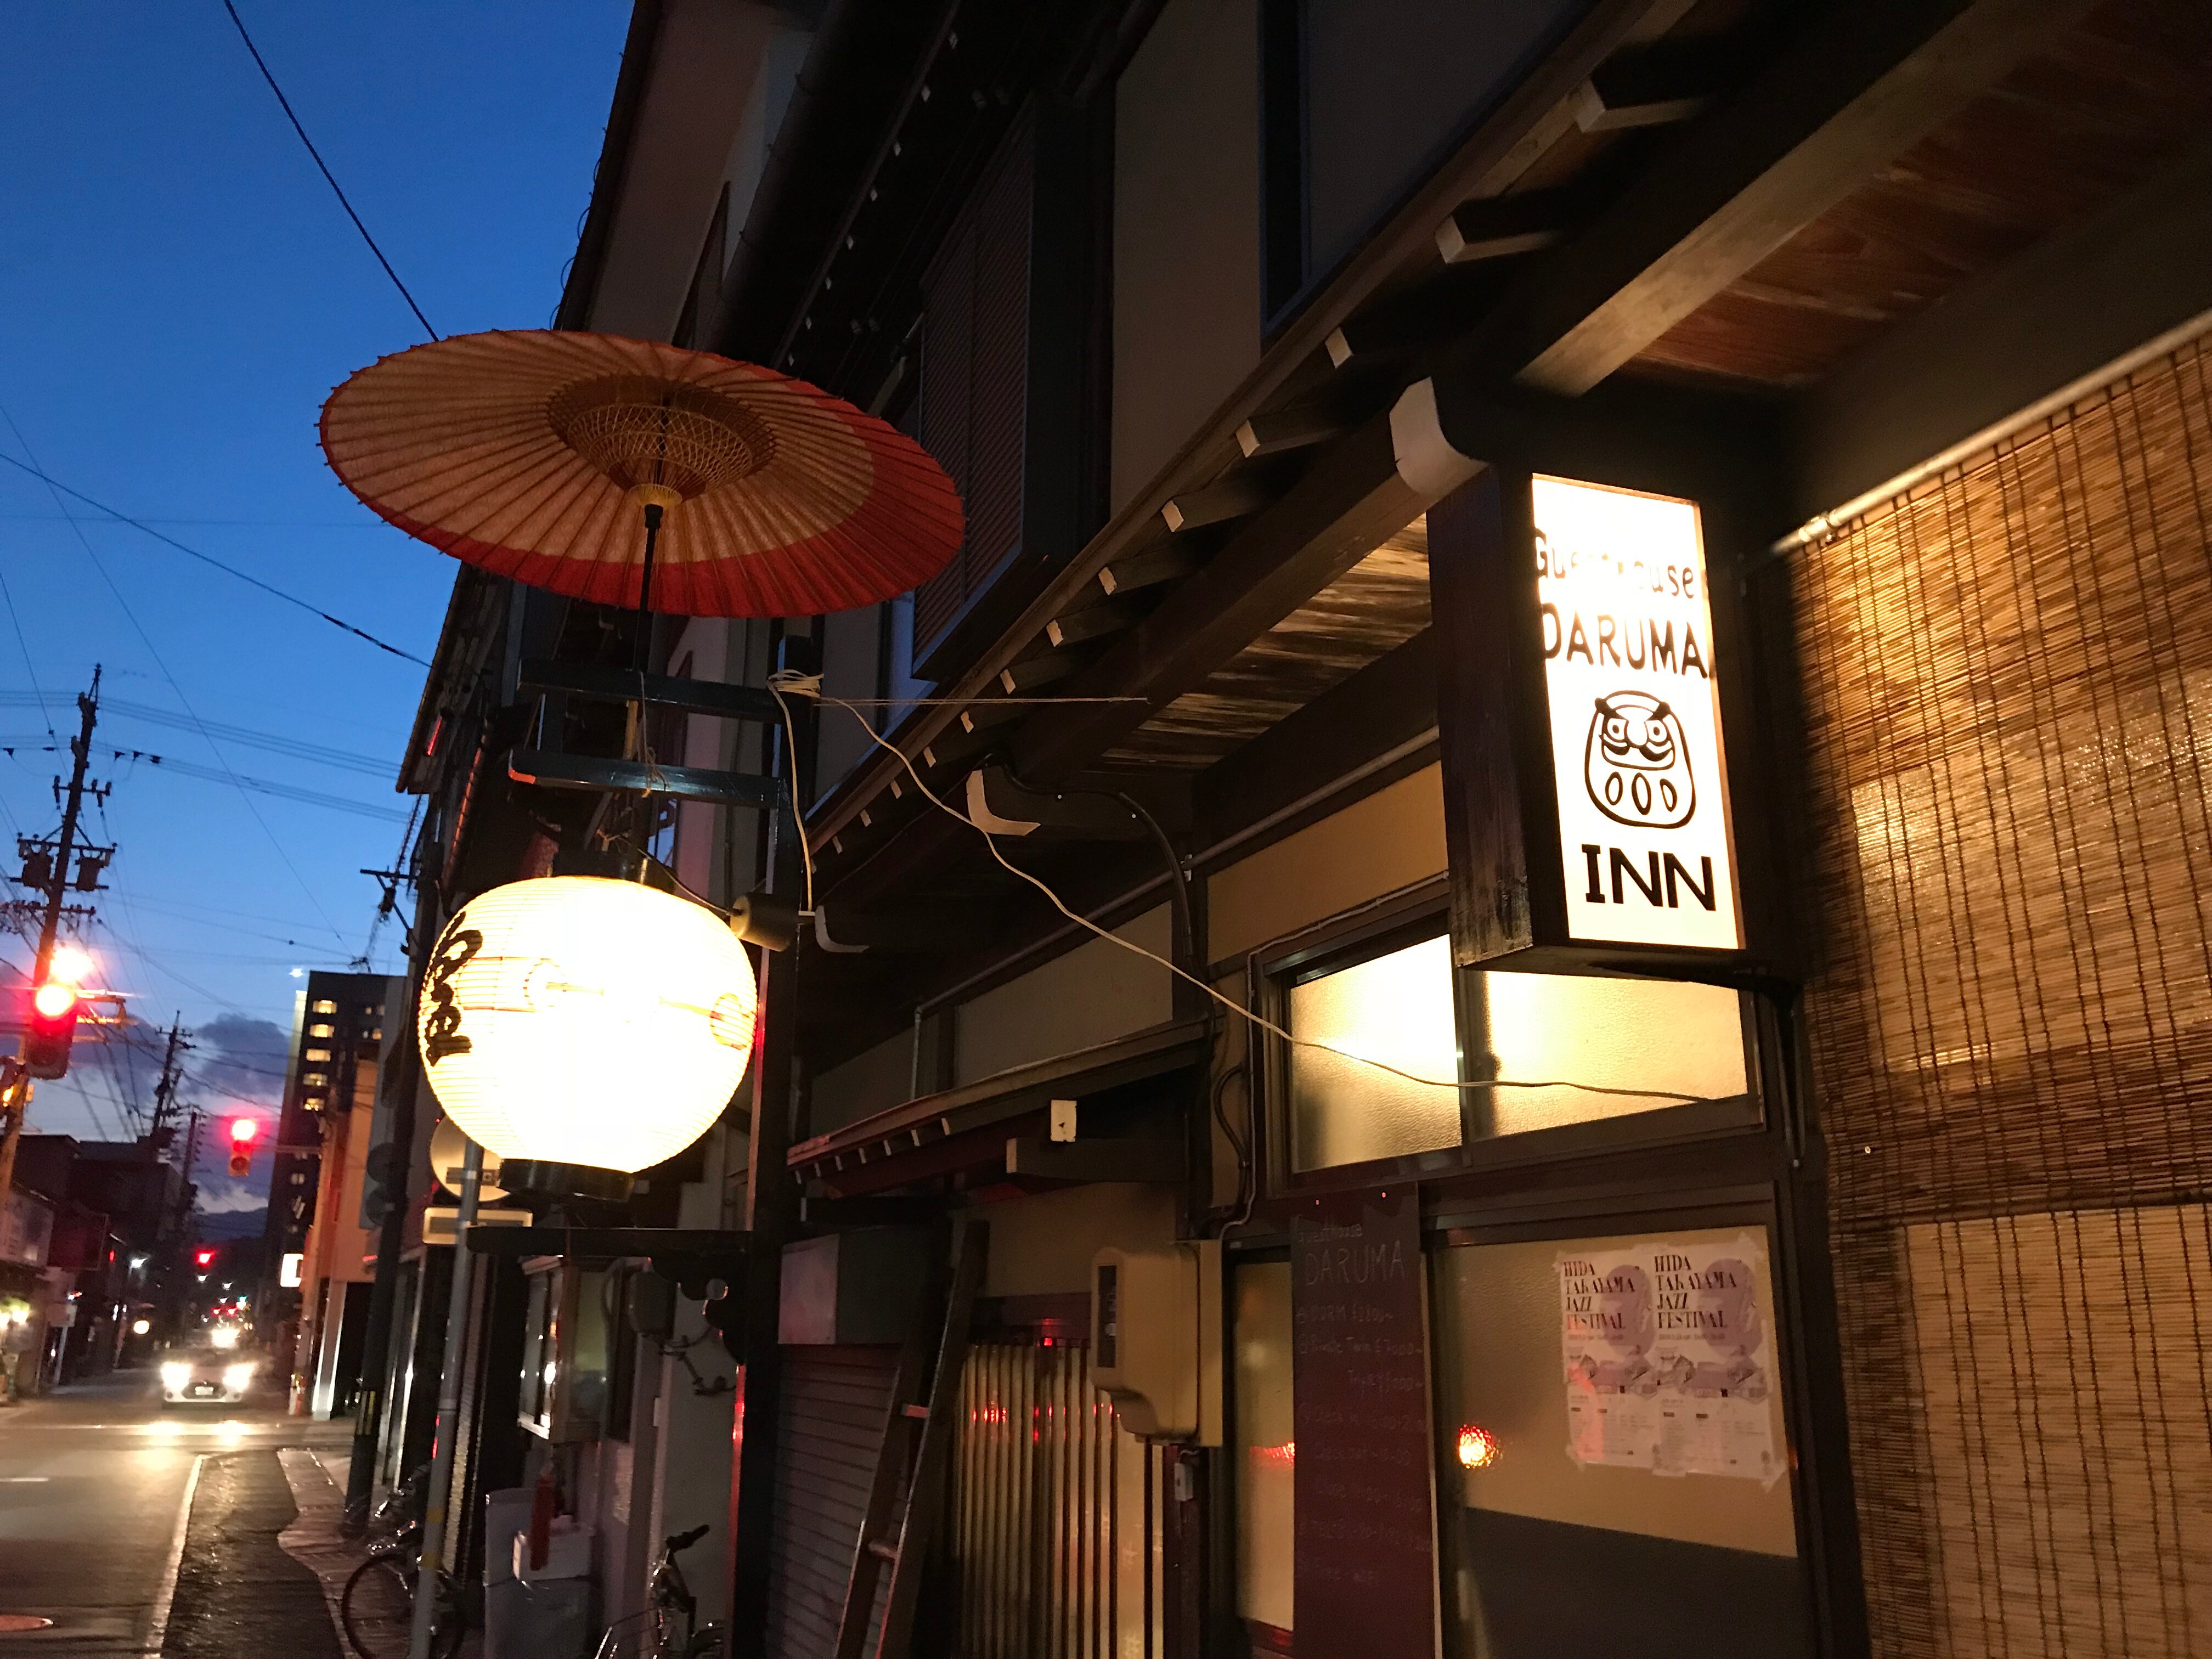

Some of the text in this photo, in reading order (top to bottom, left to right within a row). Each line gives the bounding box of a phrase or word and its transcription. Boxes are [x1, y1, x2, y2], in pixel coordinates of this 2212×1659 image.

[1541, 602, 1708, 679] DARUMA
[1582, 844, 1716, 911] INN
[1305, 1239, 1406, 1285] DARUMA
[1564, 1261, 1595, 1277] HIDA
[1655, 1255, 1691, 1272] HIDA
[1565, 1277, 1635, 1294] TAKAYAMA
[1656, 1271, 1737, 1291] TAKAYAMA
[1566, 1296, 1593, 1312] JAZZ
[1657, 1293, 1689, 1310] JAZZ
[1567, 1313, 1626, 1329] FESTIVAL
[1658, 1310, 1728, 1328] FESTIVAL
